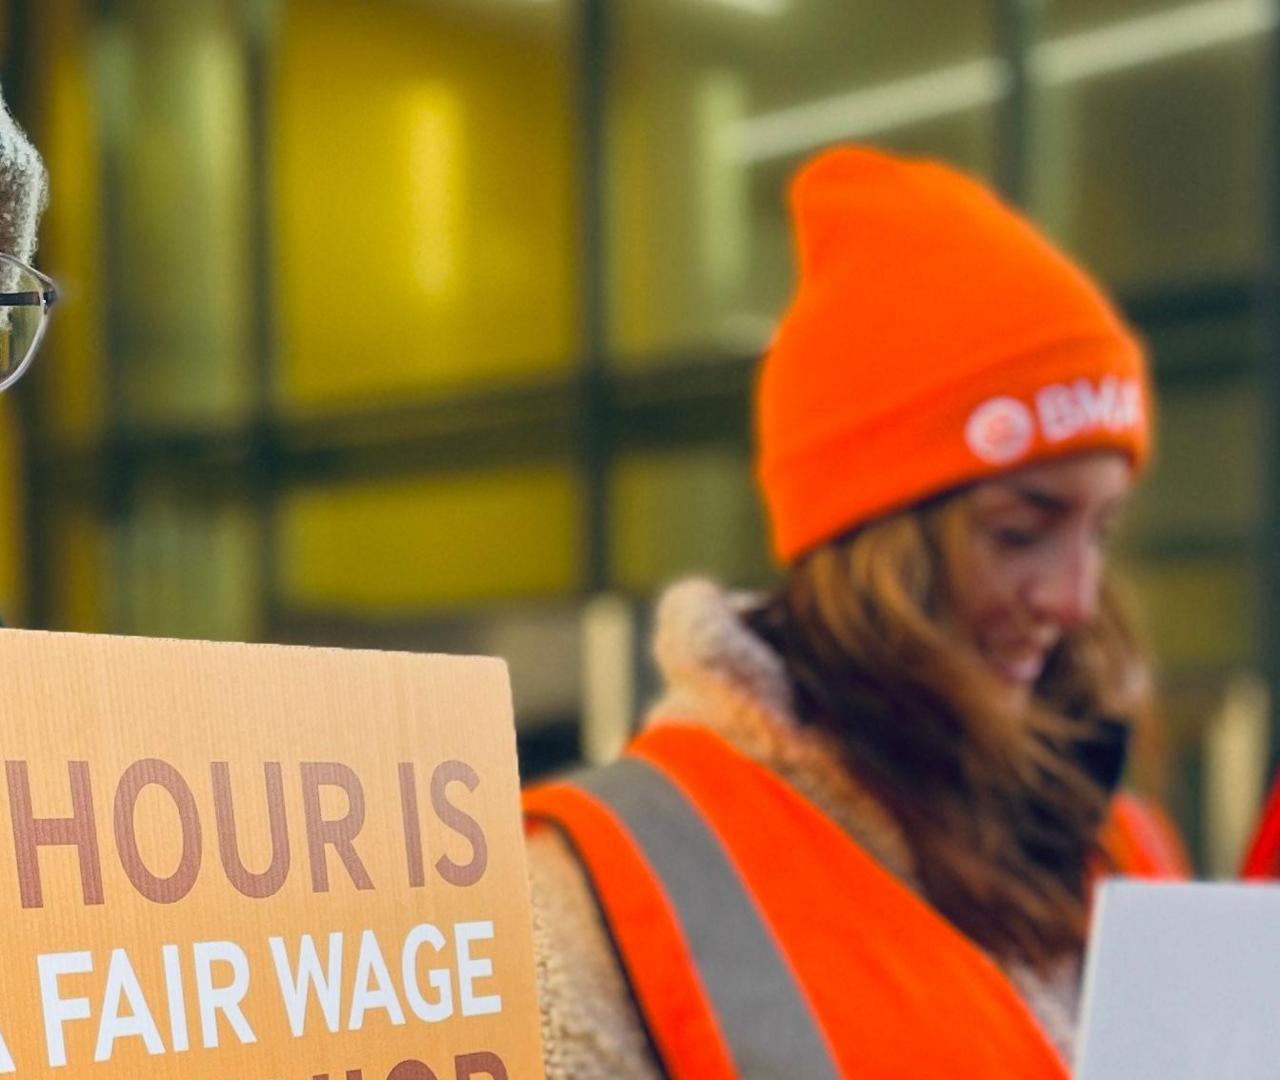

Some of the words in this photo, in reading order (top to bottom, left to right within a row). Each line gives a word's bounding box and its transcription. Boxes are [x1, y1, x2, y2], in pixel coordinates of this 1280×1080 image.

[396, 759, 489, 890] IS
[36, 940, 257, 1069] FAIR
[266, 920, 503, 1038] WAGE
